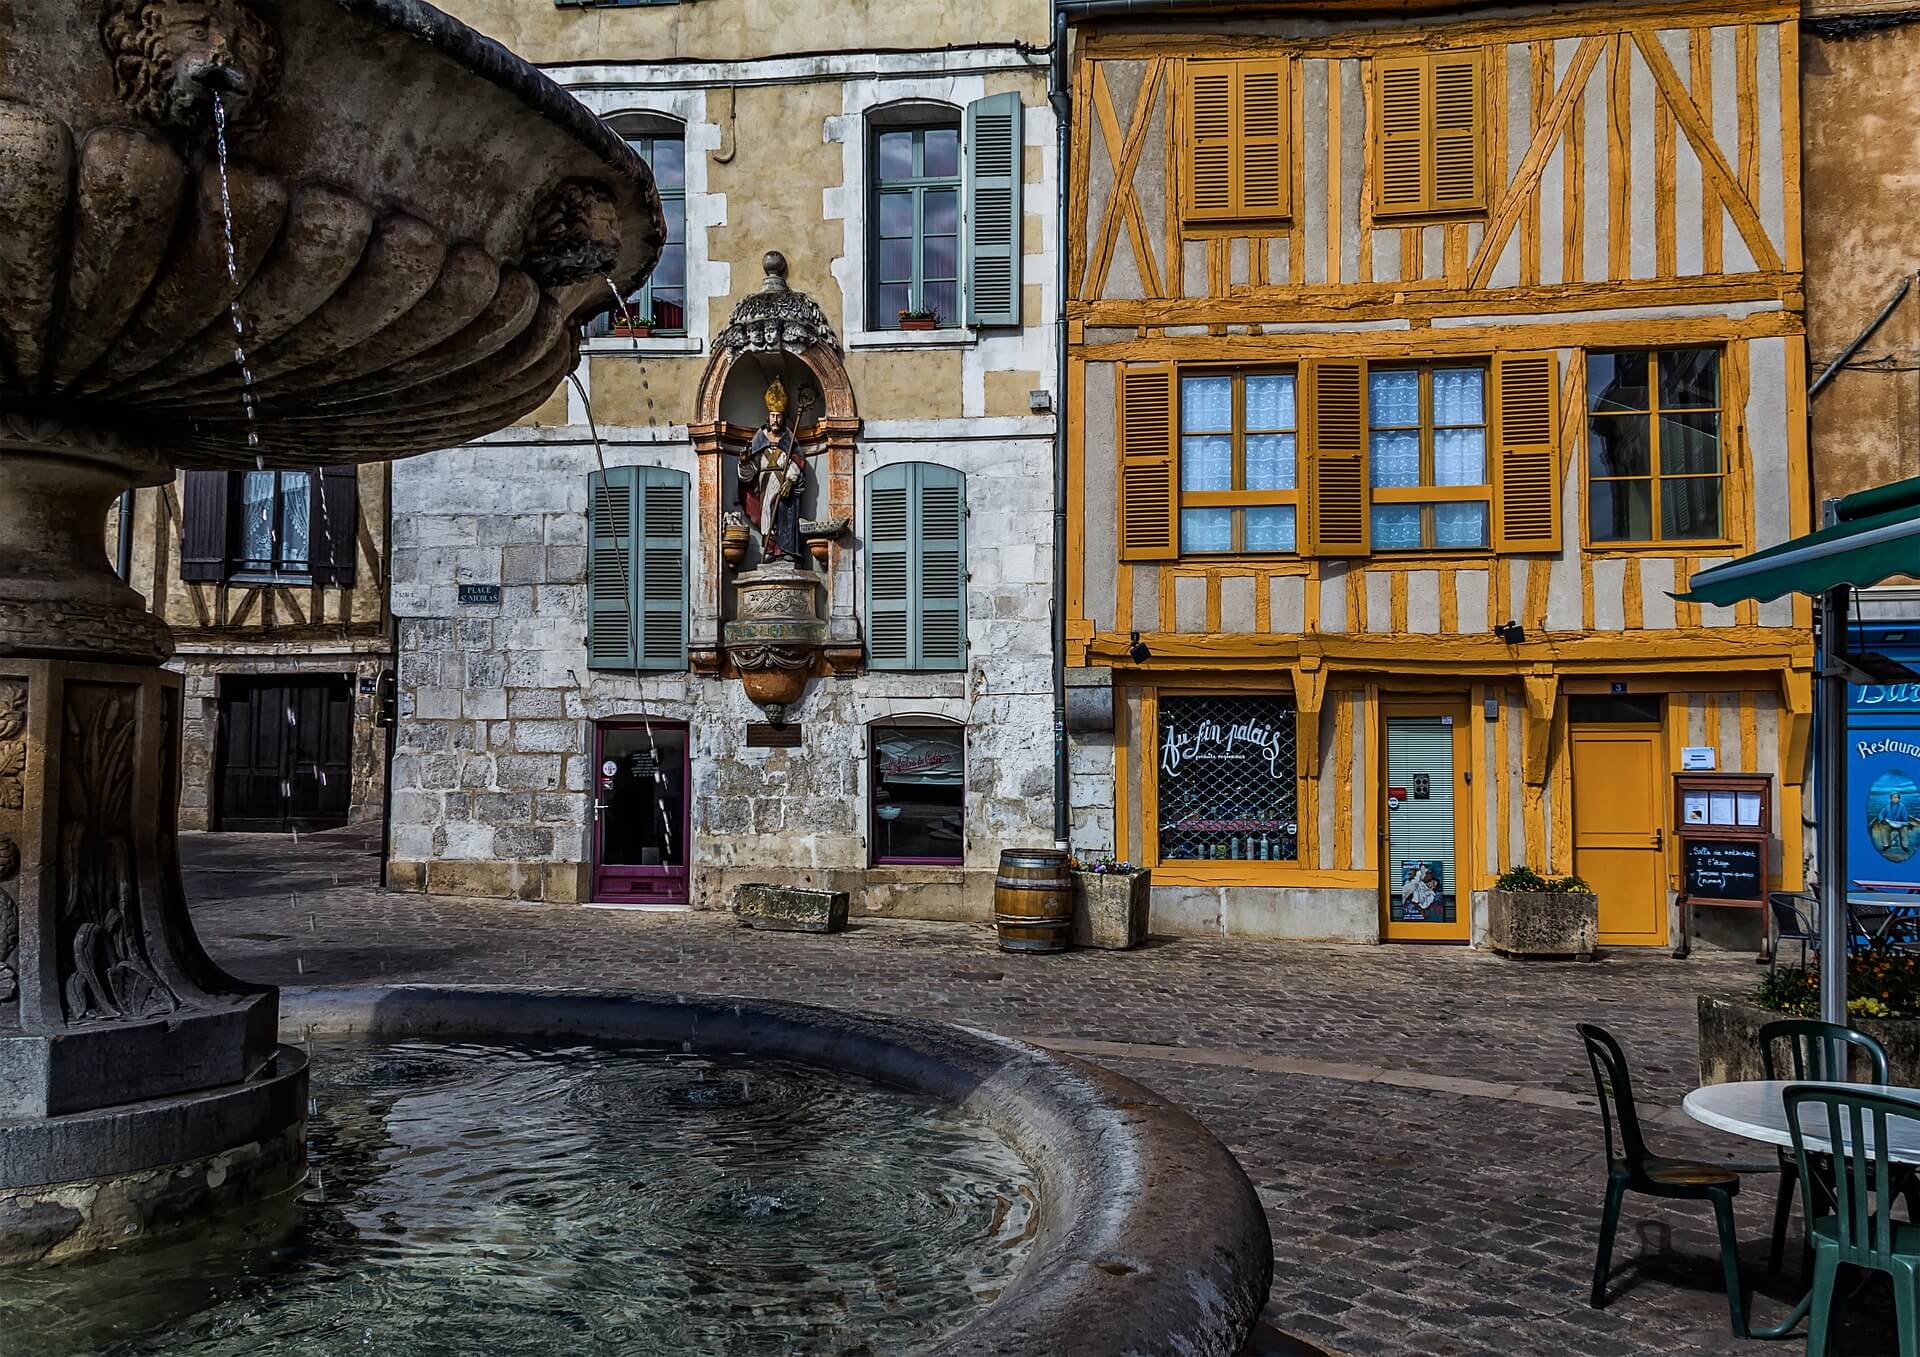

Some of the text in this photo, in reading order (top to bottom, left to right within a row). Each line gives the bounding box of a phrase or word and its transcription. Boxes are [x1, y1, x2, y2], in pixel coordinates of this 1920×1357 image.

[467, 586, 491, 594] PLACE
[1161, 718, 1283, 779] Au fin palais
